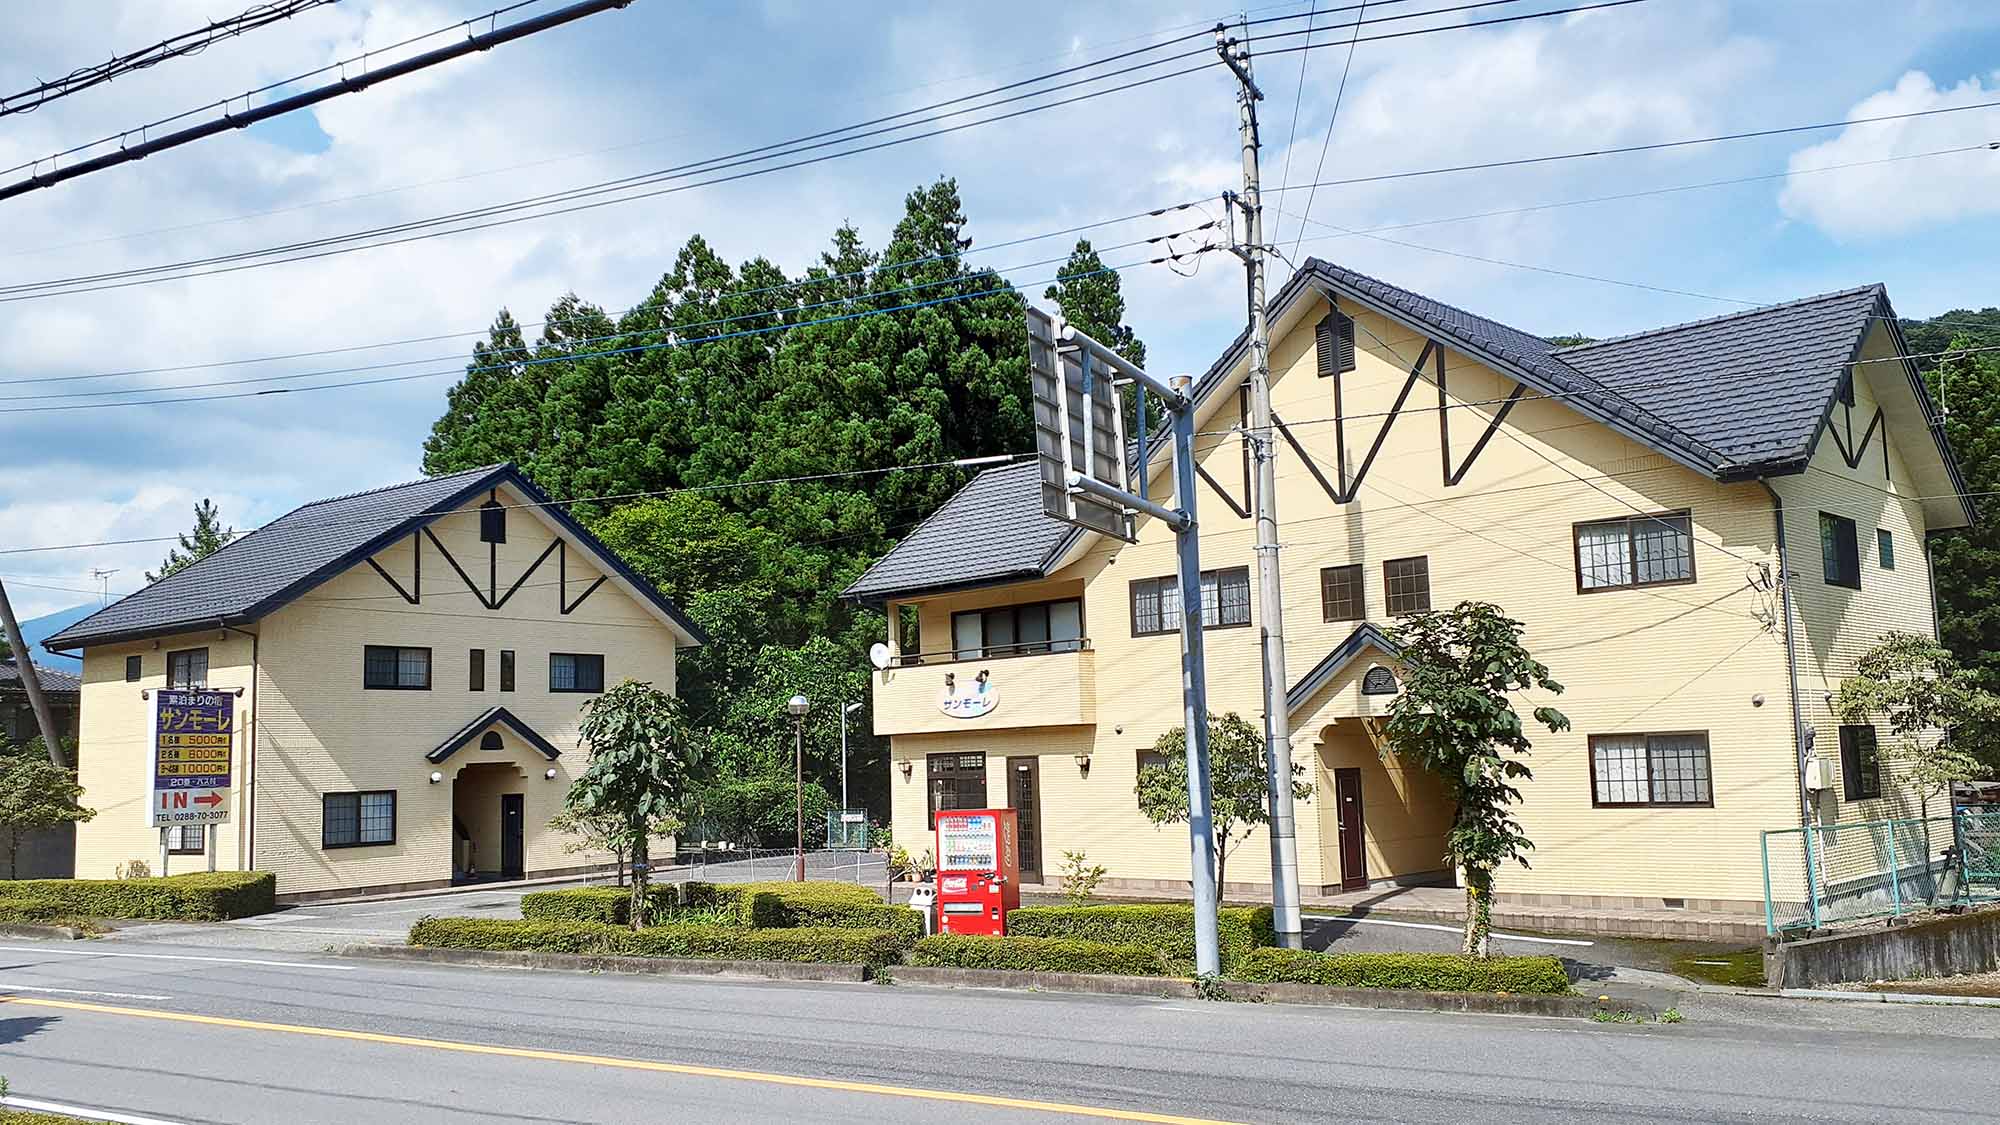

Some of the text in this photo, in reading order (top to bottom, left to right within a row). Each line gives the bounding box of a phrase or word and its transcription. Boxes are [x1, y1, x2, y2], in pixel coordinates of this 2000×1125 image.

[943, 697, 992, 711] サンモーレ
[160, 707, 230, 730] サンモーレ
[161, 791, 188, 810] IN
[174, 810, 229, 821] 0288-70-3077
